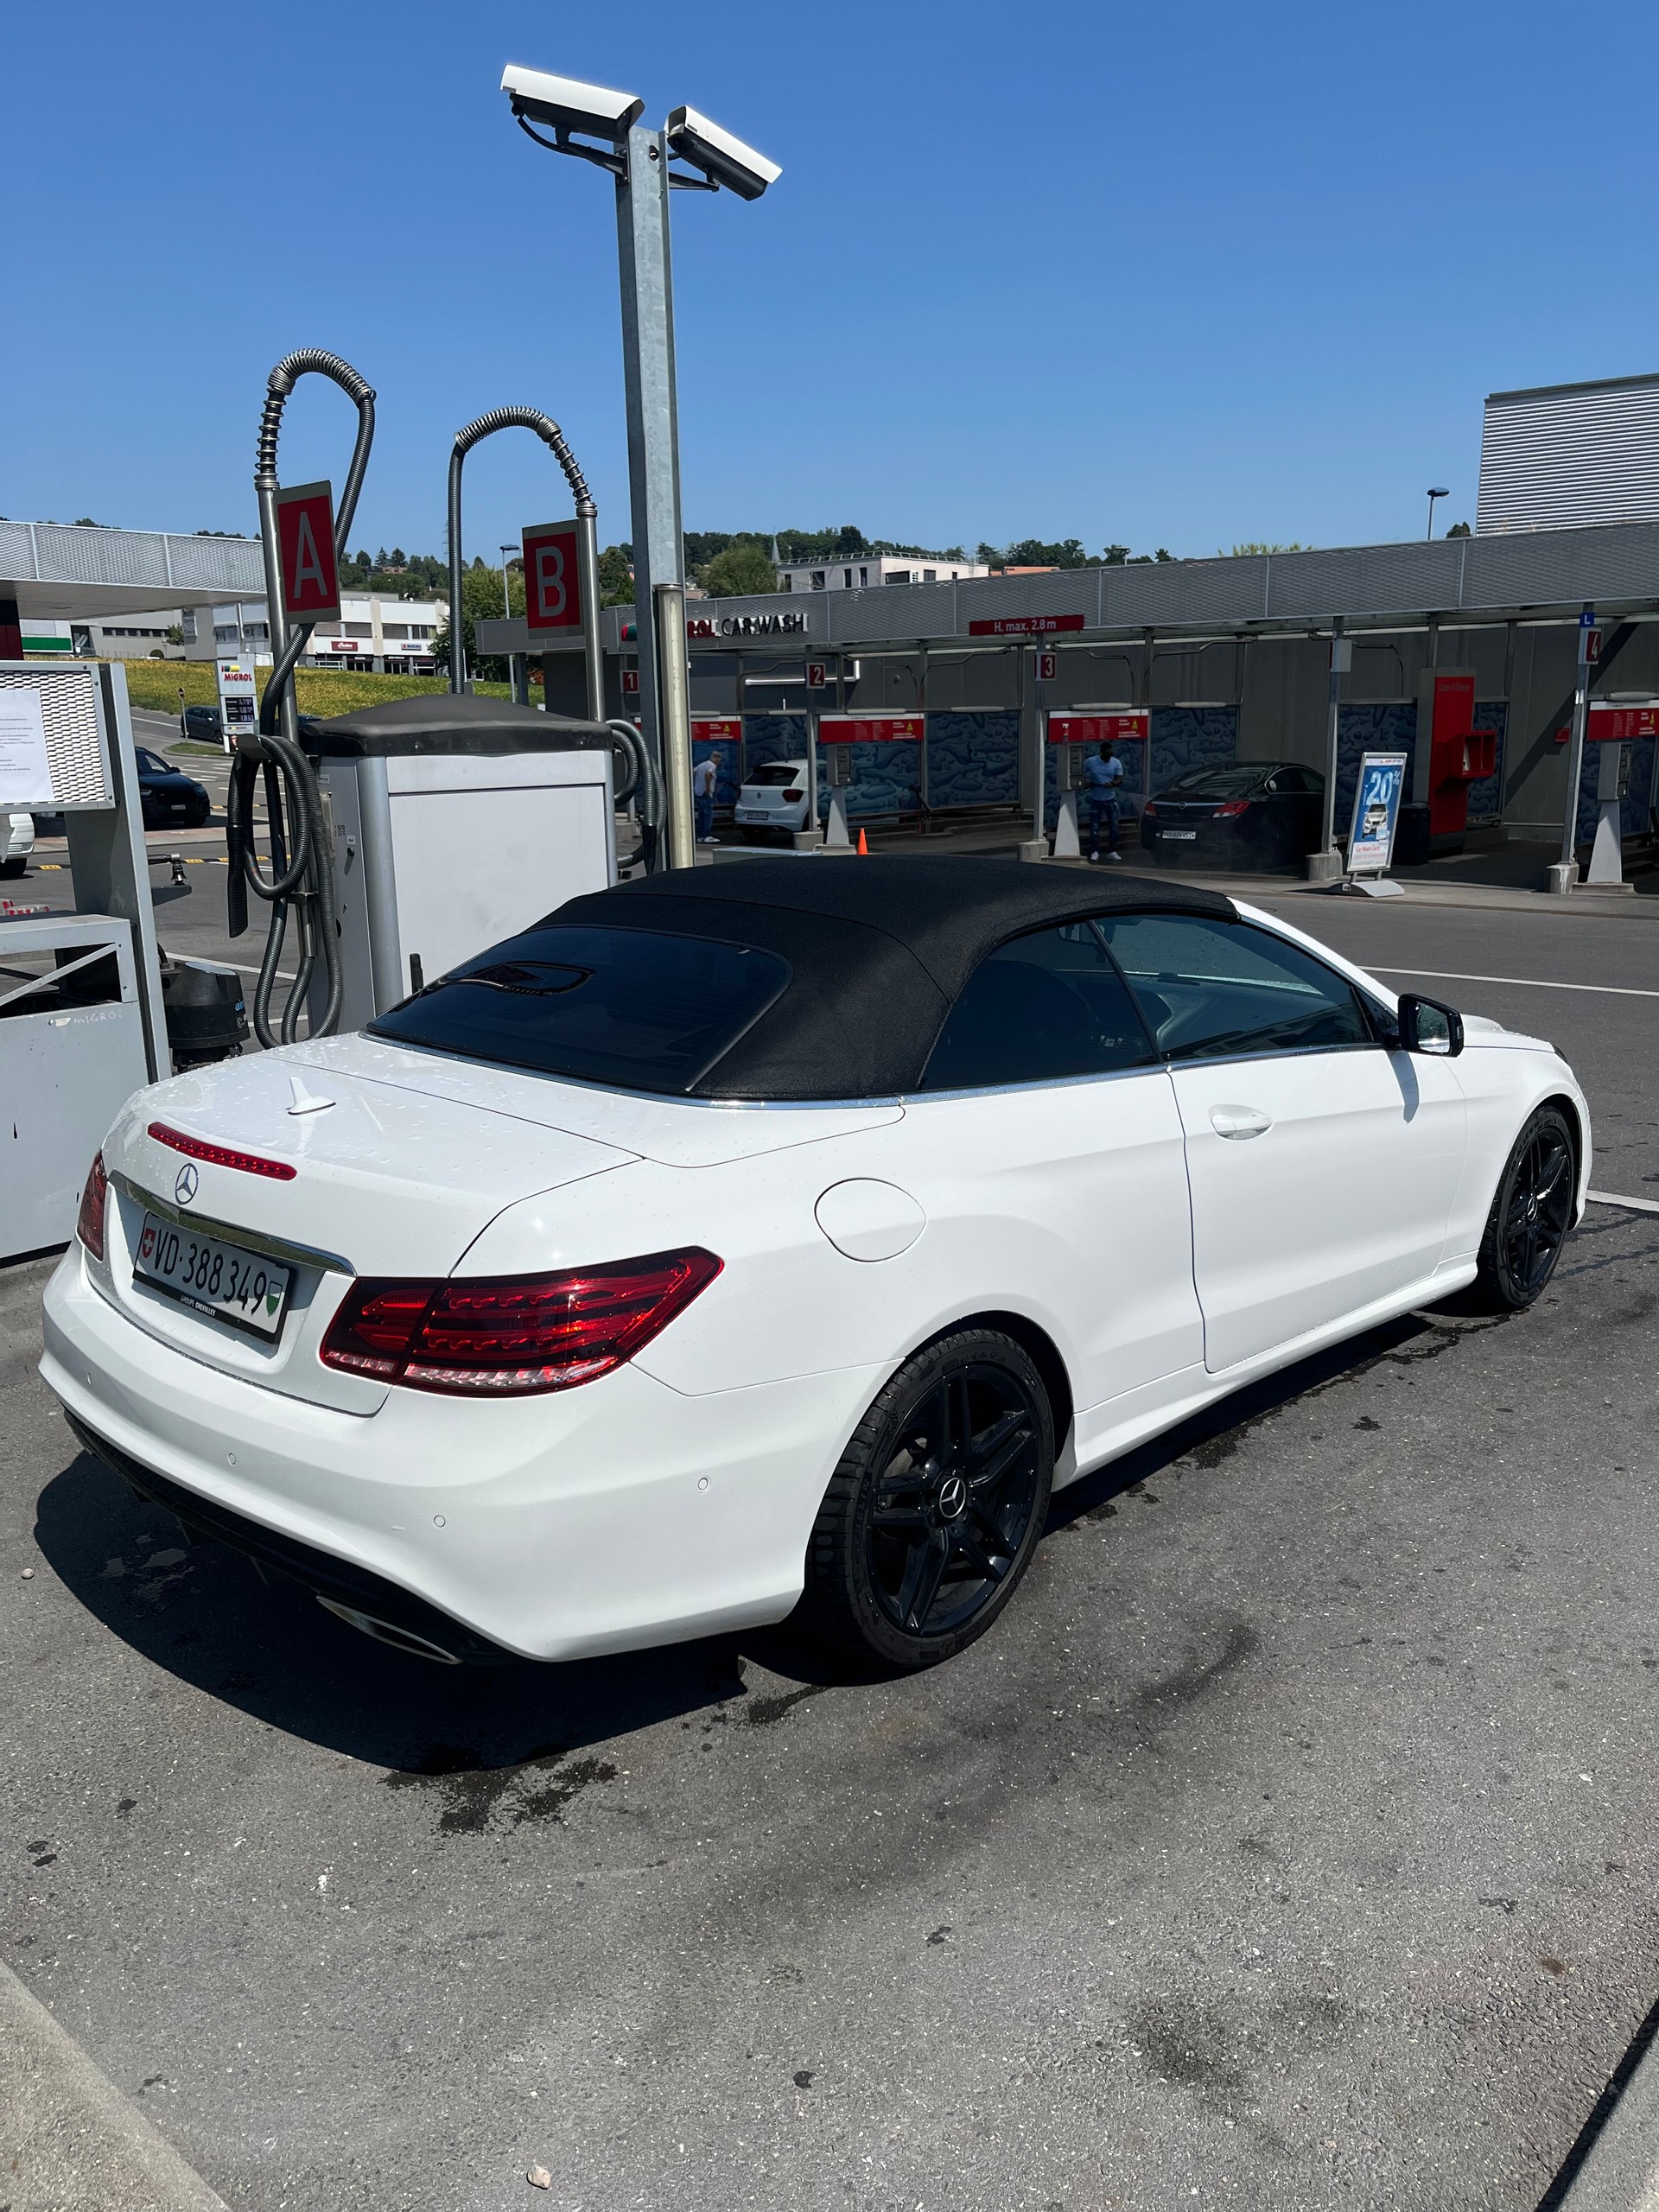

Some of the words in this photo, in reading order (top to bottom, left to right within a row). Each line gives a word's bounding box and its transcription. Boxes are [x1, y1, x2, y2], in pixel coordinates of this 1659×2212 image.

[293, 512, 328, 599] A
[535, 545, 567, 618] B
[1006, 622, 1029, 632] max.
[1584, 614, 1591, 625] L
[1591, 633, 1599, 658] 4
[813, 666, 822, 684] 2
[1045, 657, 1053, 677] 3
[224, 673, 252, 682] MIGROL
[627, 673, 634, 690] 1
